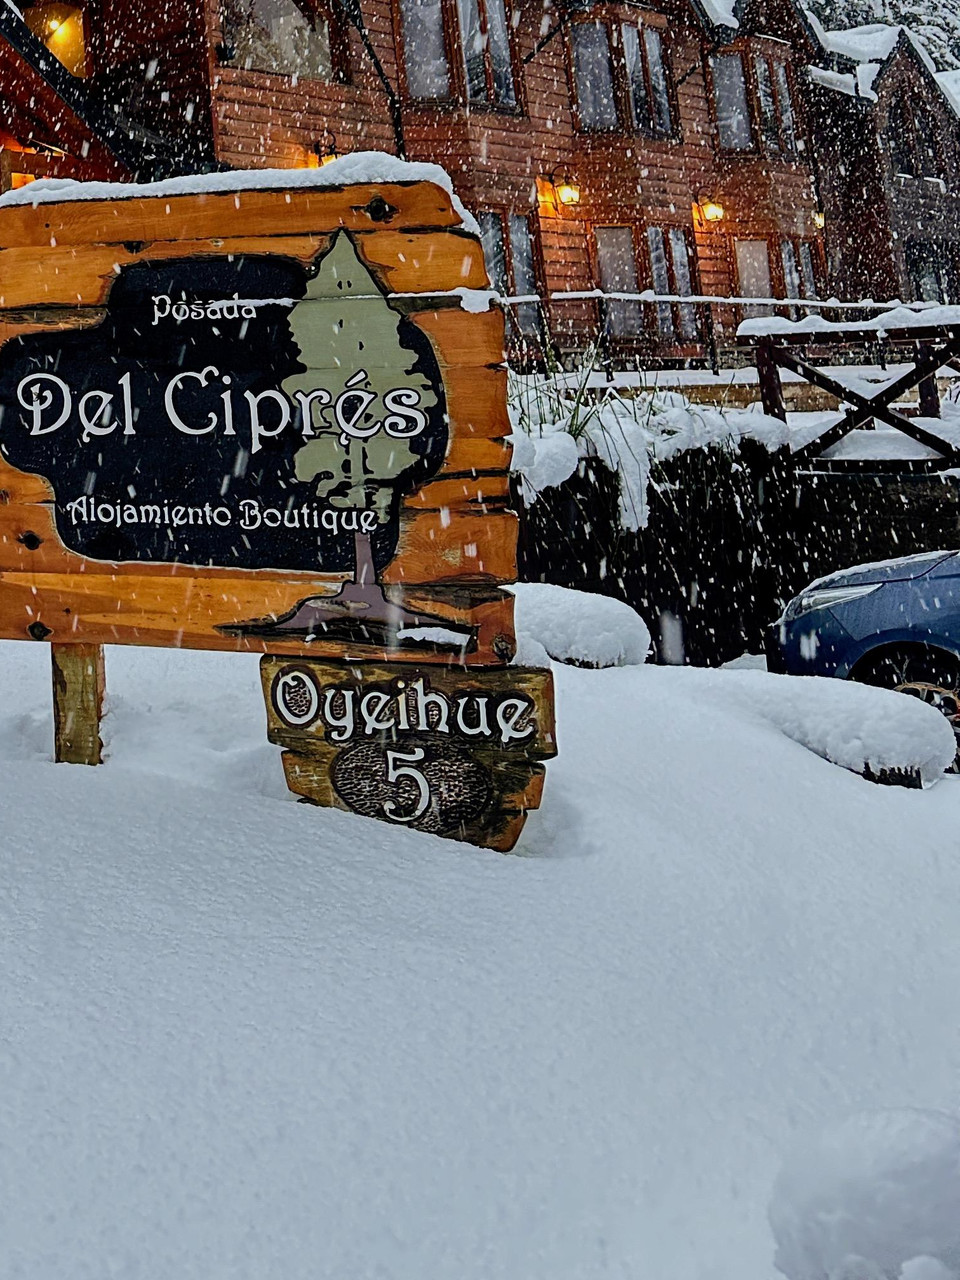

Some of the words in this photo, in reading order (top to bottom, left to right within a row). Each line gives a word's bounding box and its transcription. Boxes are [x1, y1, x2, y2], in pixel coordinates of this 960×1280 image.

[17, 371, 136, 443] Del
[164, 365, 427, 454] Ciprés
[66, 496, 232, 528] Alojamiento
[239, 499, 378, 535] Boutique
[276, 670, 535, 743] Oyeihue
[382, 747, 430, 822] 5
